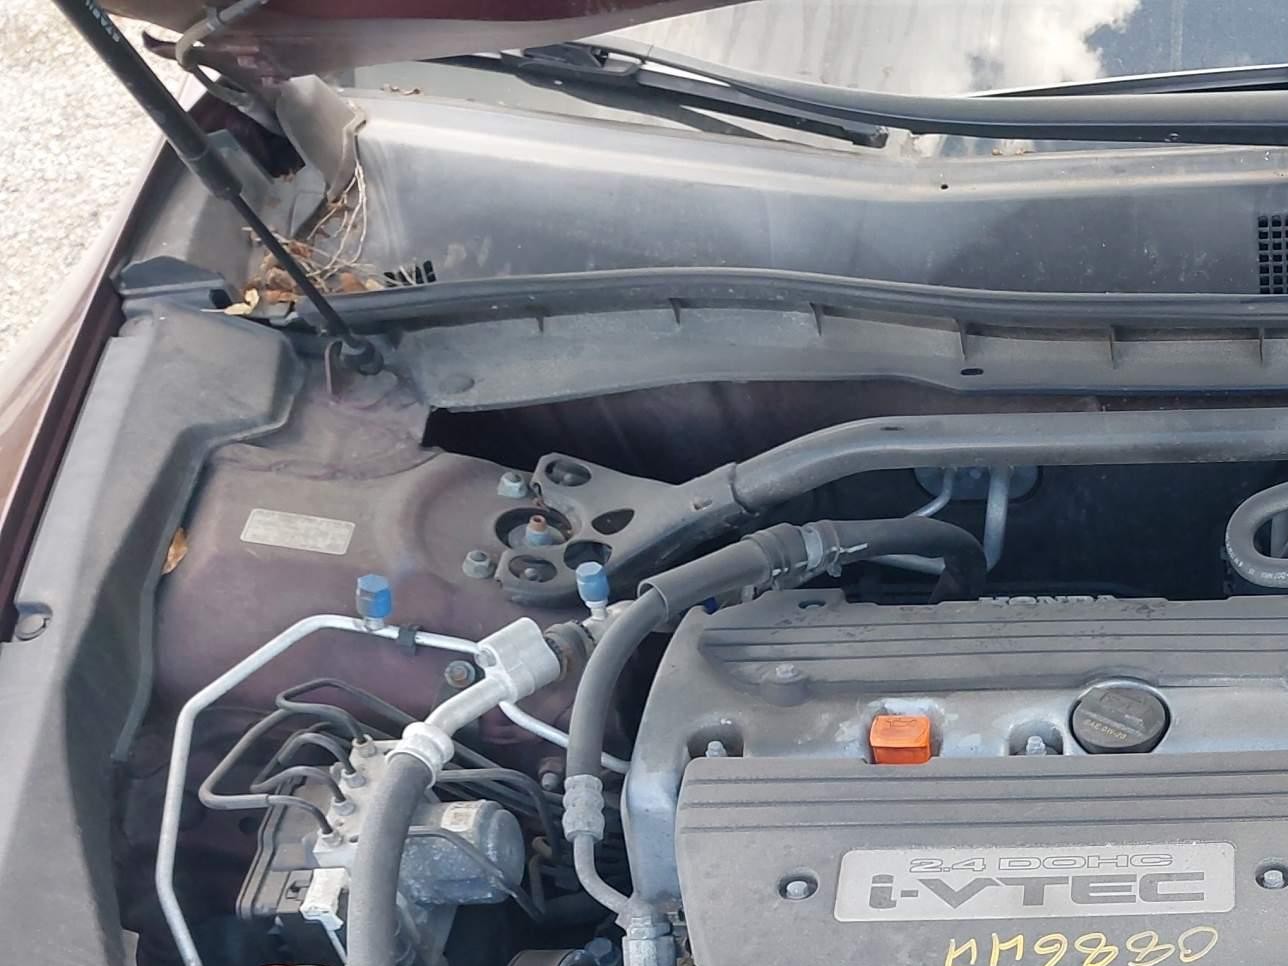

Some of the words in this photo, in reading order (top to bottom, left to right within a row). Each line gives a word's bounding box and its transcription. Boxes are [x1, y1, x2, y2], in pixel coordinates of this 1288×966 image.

[909, 857, 986, 873] 2.4
[999, 854, 1173, 869] DOHC
[869, 872, 1204, 909] i-VTEC
